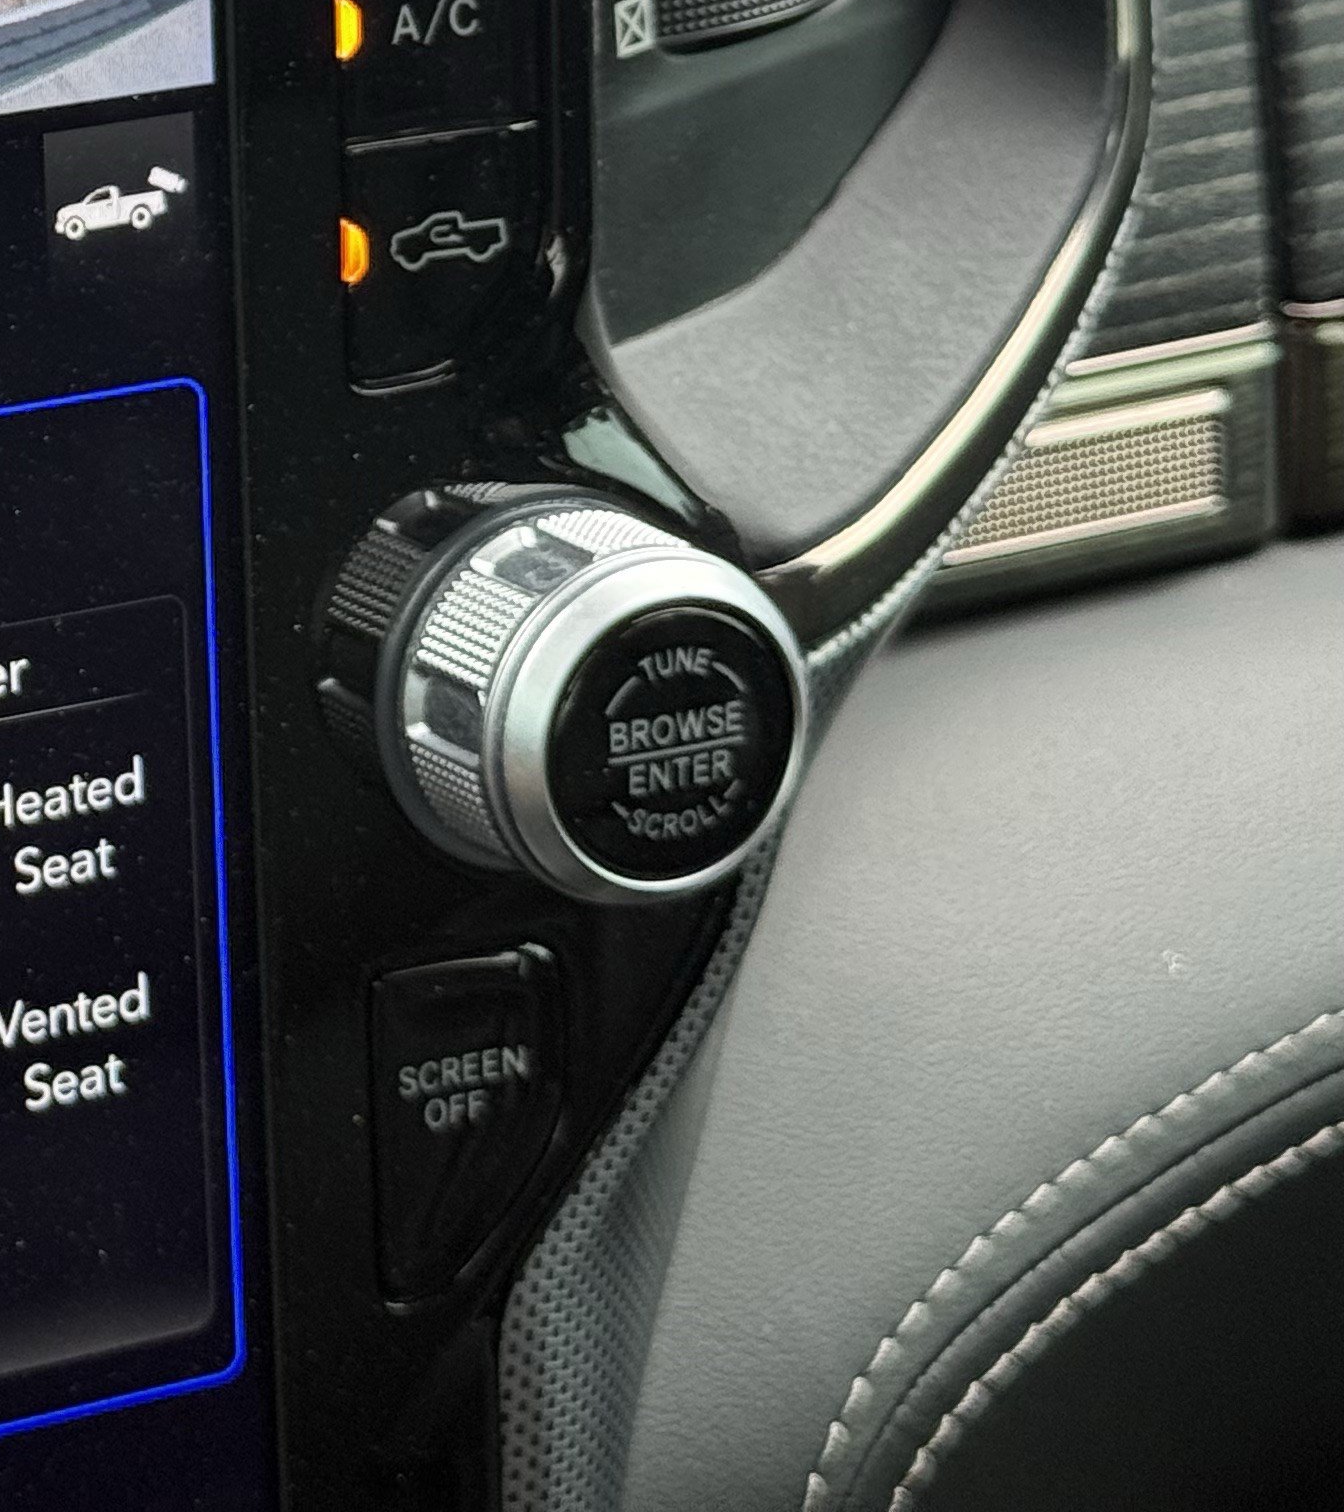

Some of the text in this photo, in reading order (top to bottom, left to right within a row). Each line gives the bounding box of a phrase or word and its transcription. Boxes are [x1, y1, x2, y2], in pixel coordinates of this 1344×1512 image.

[637, 647, 713, 681] TUNE
[609, 699, 744, 752] BROWSE
[628, 750, 734, 795] ENTER
[627, 796, 731, 839] SCROLL
[15, 838, 116, 895] Seat
[24, 1053, 127, 1112] Seat
[398, 1044, 529, 1096] SCREEN
[424, 1090, 488, 1132] OFF
